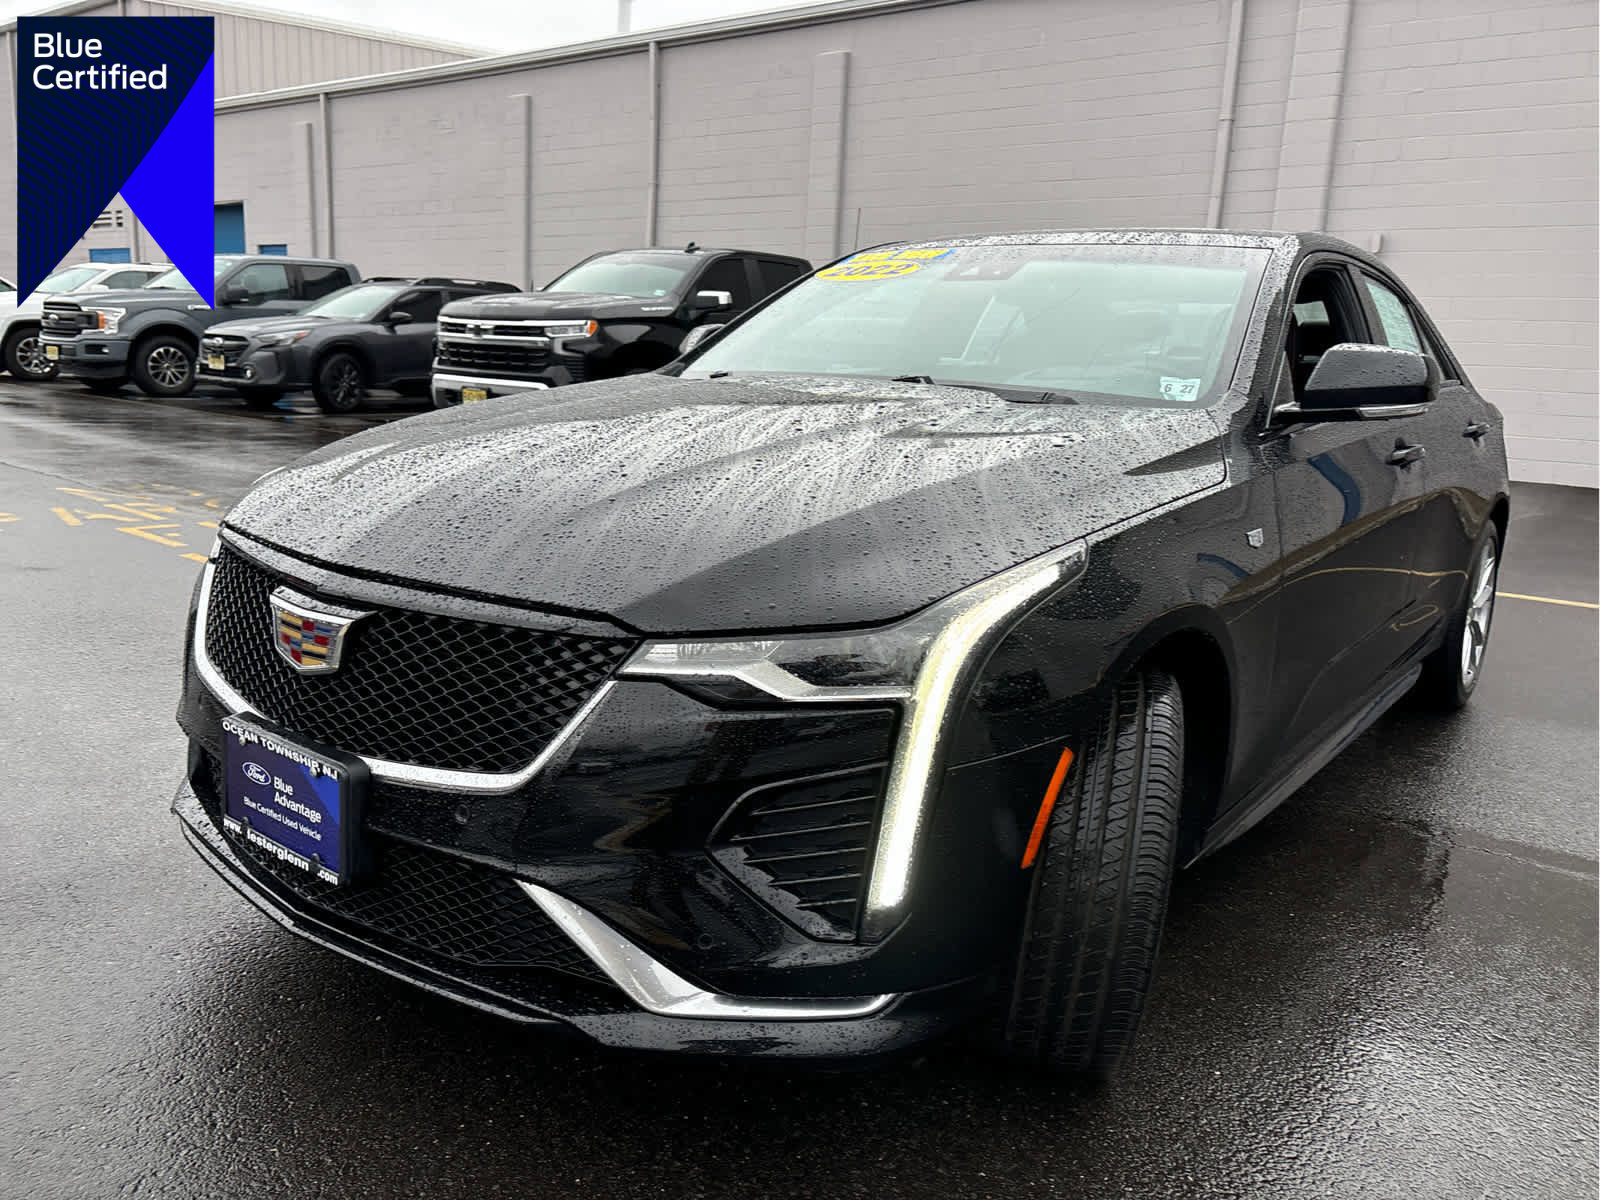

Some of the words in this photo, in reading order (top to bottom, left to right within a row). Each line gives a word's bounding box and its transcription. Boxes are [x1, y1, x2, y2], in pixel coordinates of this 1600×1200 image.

[1164, 383, 1174, 393] 6
[1180, 384, 1195, 394] 27
[222, 721, 259, 744] OCEAN
[322, 765, 339, 780] NJ
[273, 776, 294, 796] Blue
[243, 796, 257, 810] Blue
[256, 803, 282, 822] Certified
[282, 815, 299, 830] Used
[298, 823, 322, 841] Vehicle
[274, 791, 322, 823] Advantage
[223, 817, 243, 835] www.
[246, 828, 310, 872] lesterglenn
[317, 869, 339, 886] .com
